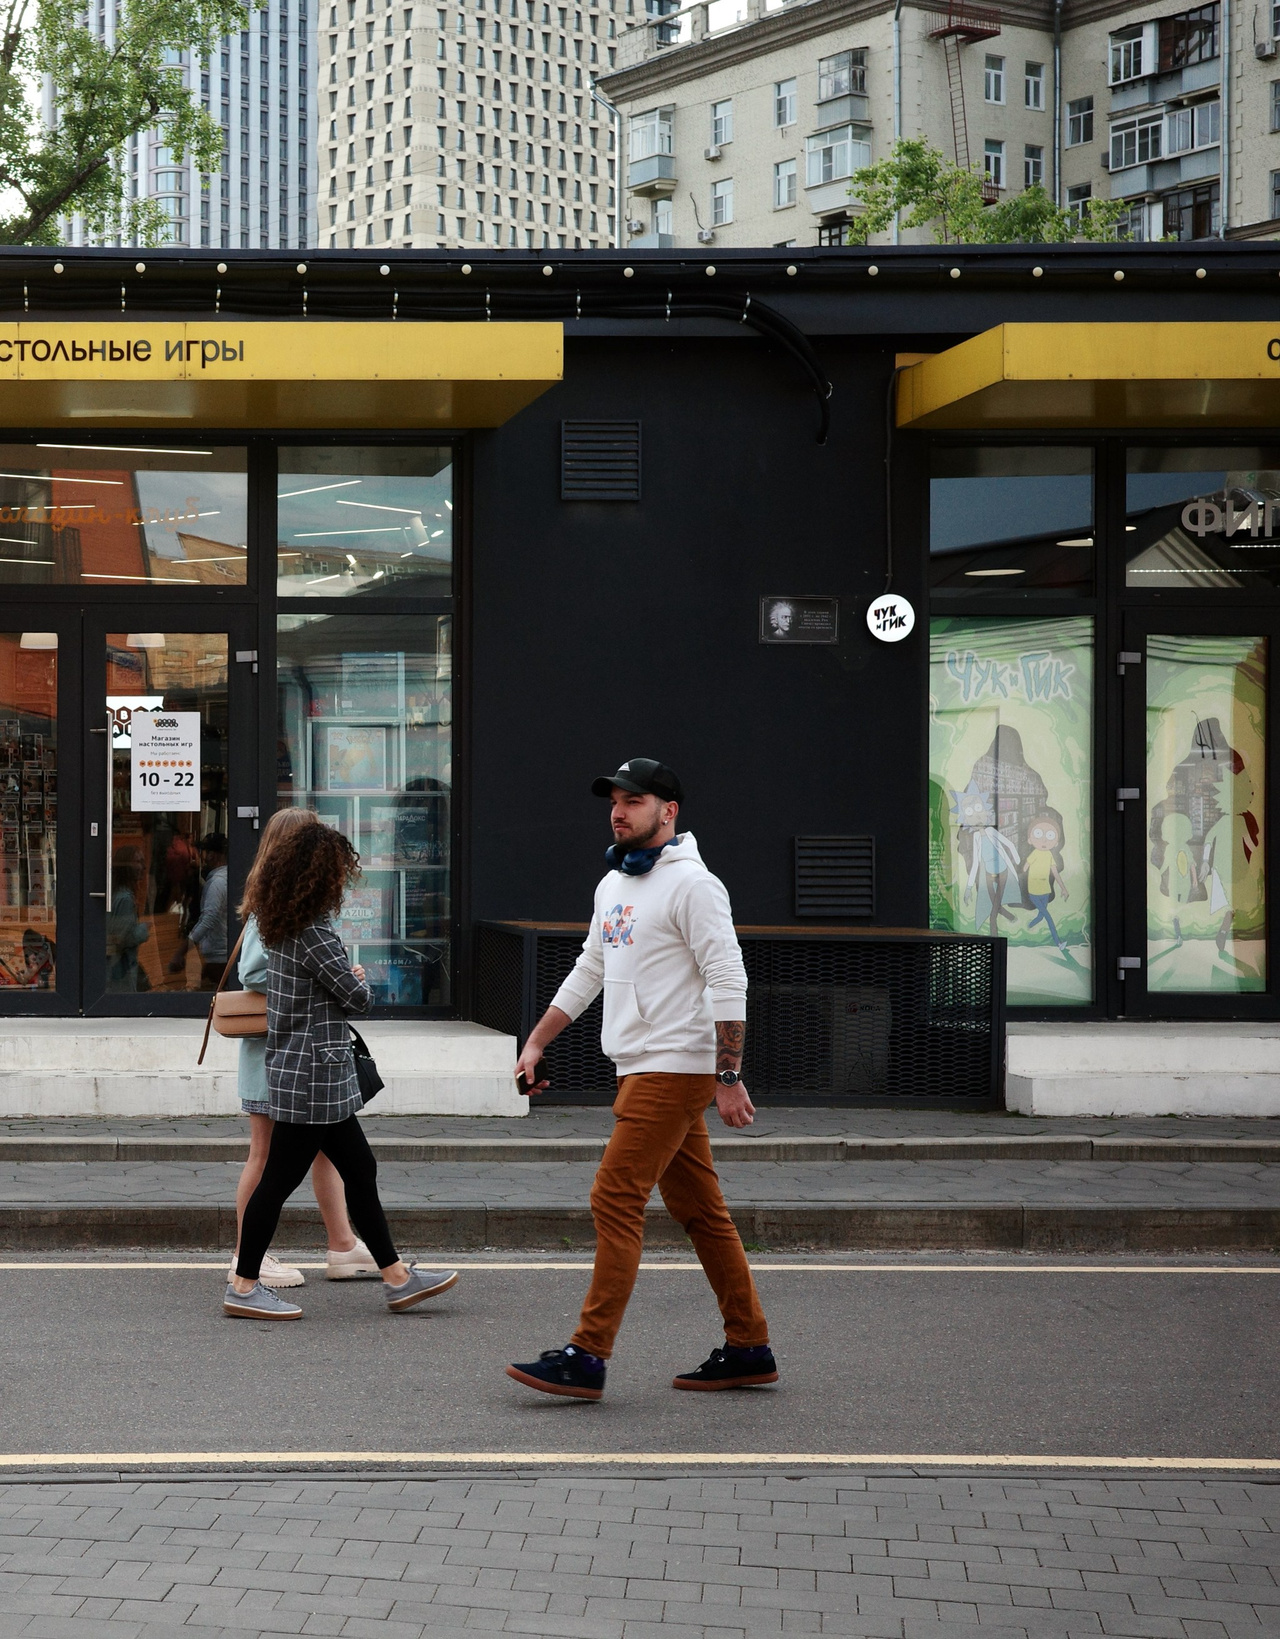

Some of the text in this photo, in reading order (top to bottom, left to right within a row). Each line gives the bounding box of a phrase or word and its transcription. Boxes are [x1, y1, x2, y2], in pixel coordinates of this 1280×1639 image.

[165, 339, 244, 369] игры
[873, 604, 898, 620] ЧУК
[882, 614, 907, 632] ГИК
[139, 772, 160, 787] 10
[174, 772, 195, 787] 22
[344, 909, 370, 918] AZUL
